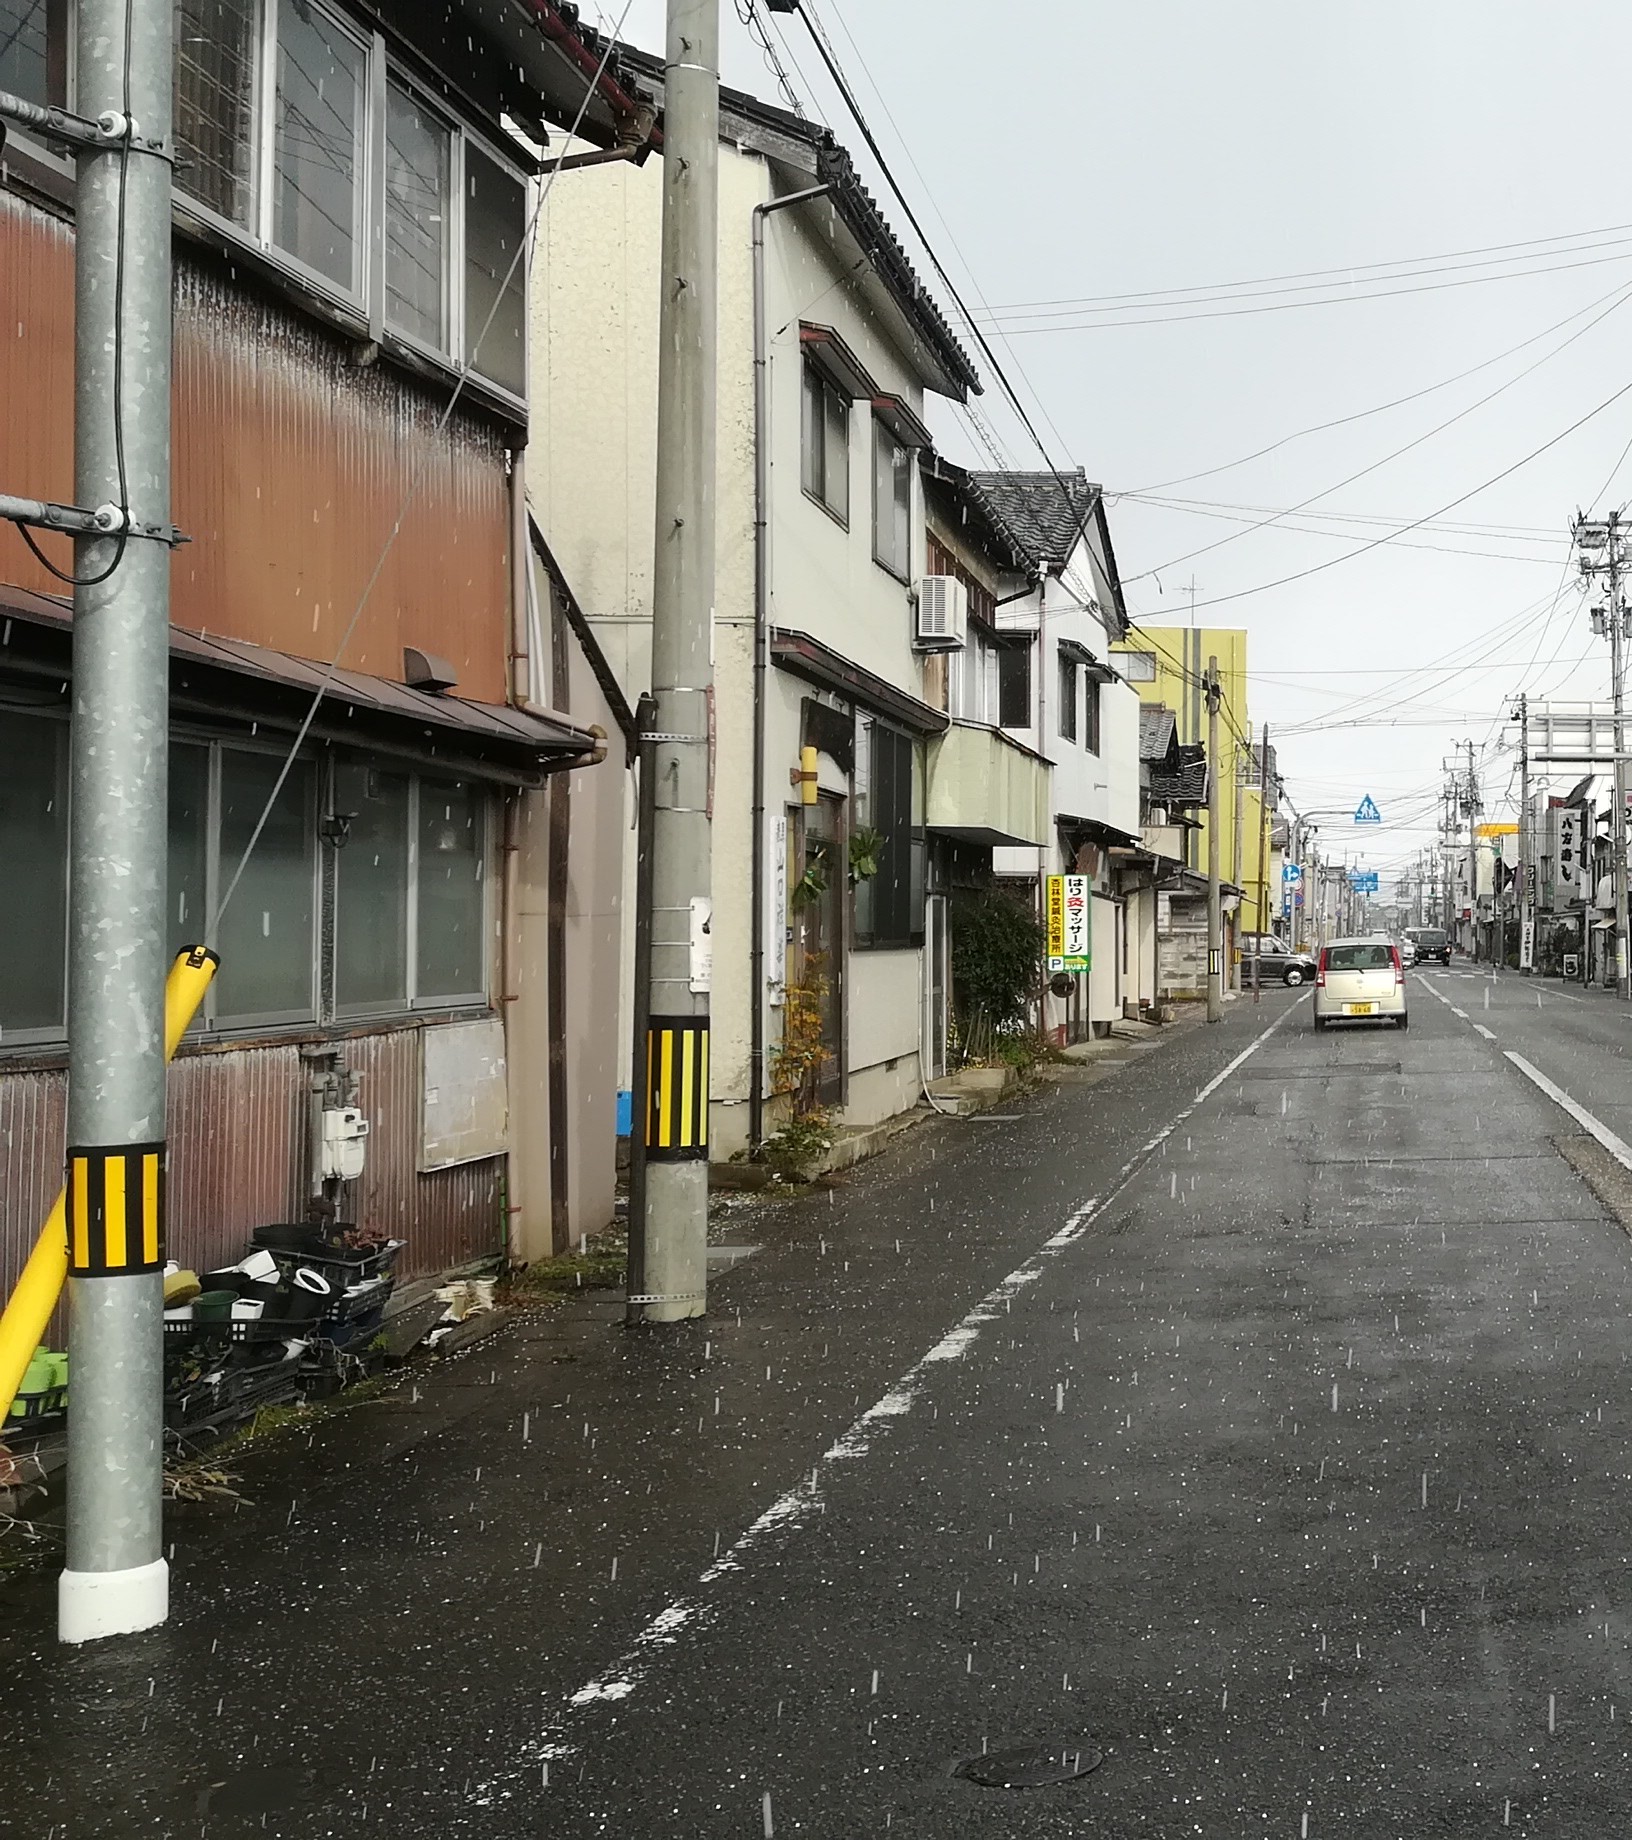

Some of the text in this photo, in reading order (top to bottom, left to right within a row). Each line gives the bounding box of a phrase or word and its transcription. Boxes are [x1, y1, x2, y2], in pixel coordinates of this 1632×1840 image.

[1067, 878, 1084, 954] はり灸マッサージ
[1051, 960, 1062, 969] P
